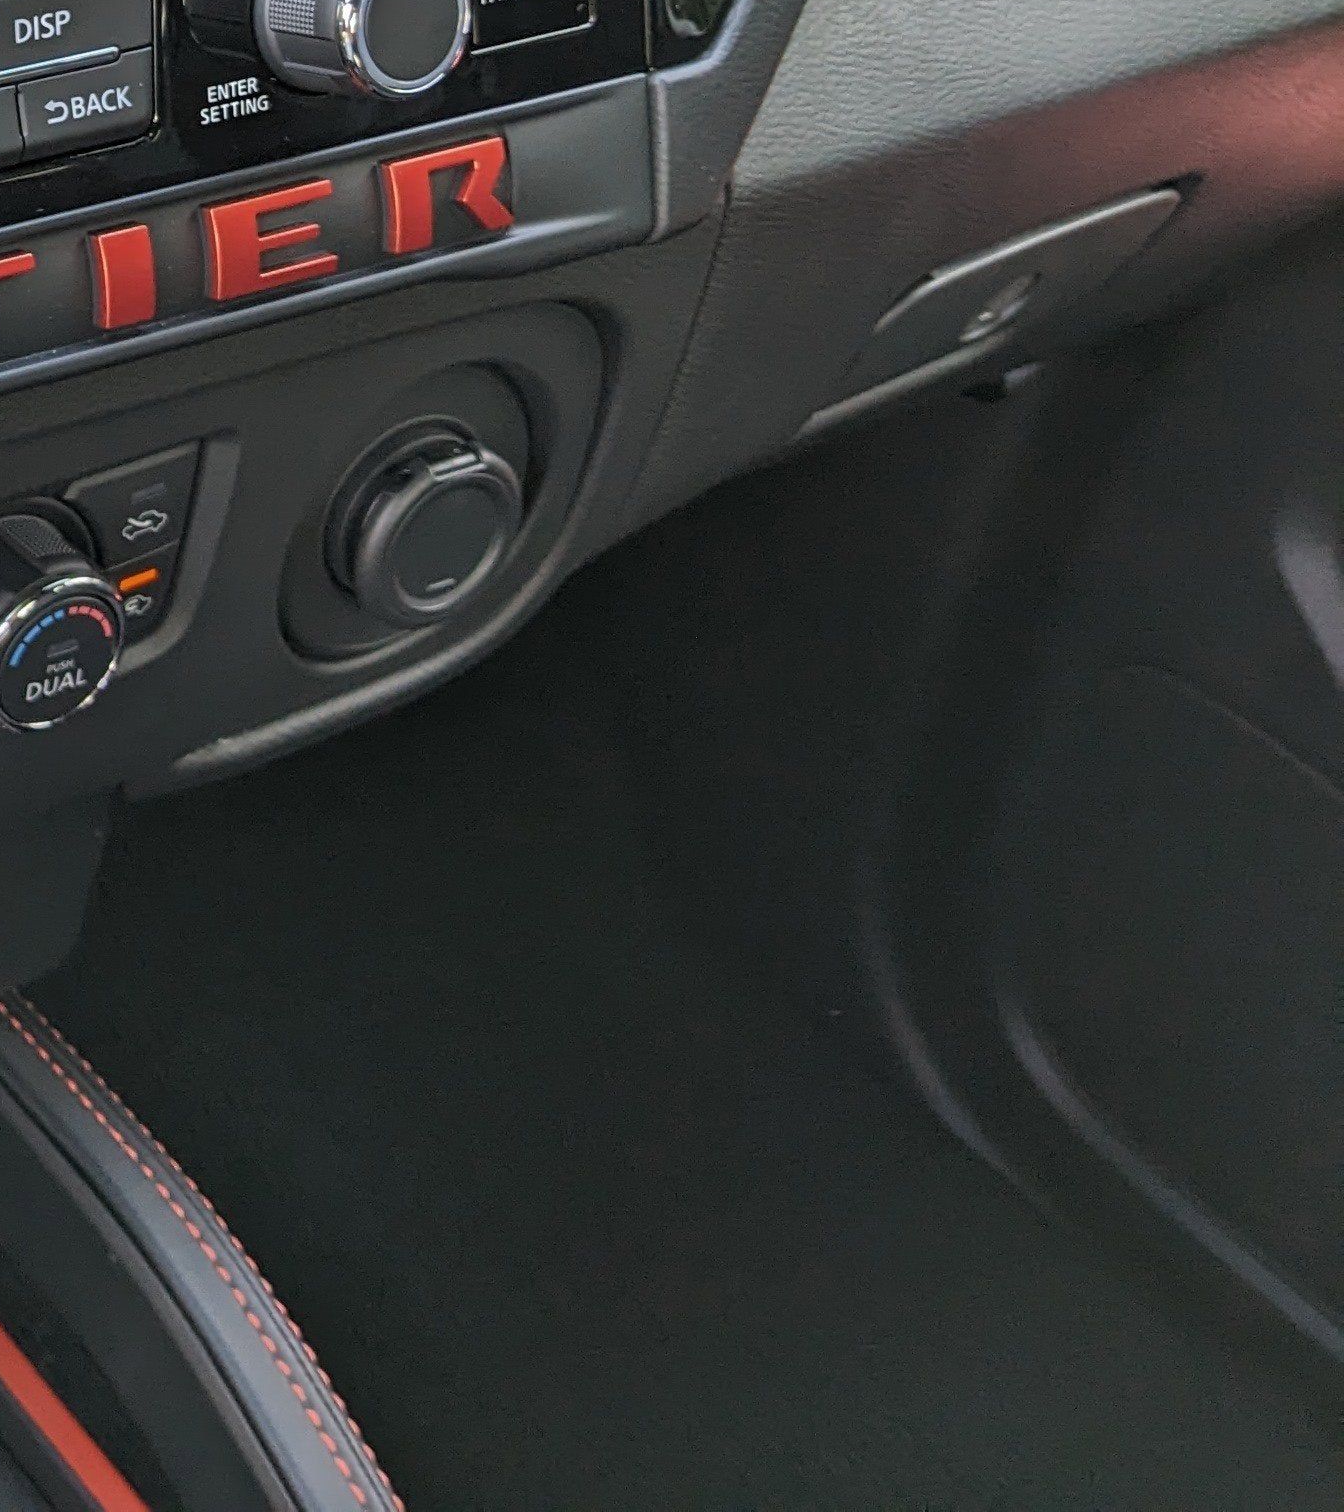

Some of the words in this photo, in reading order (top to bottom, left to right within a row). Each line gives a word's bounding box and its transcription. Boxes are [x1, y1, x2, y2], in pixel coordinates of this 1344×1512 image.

[13, 10, 73, 45] DISP
[69, 85, 134, 119] BACK
[206, 77, 260, 104] ENTER
[199, 94, 271, 127] SETTING
[25, 668, 88, 702] DUAL
